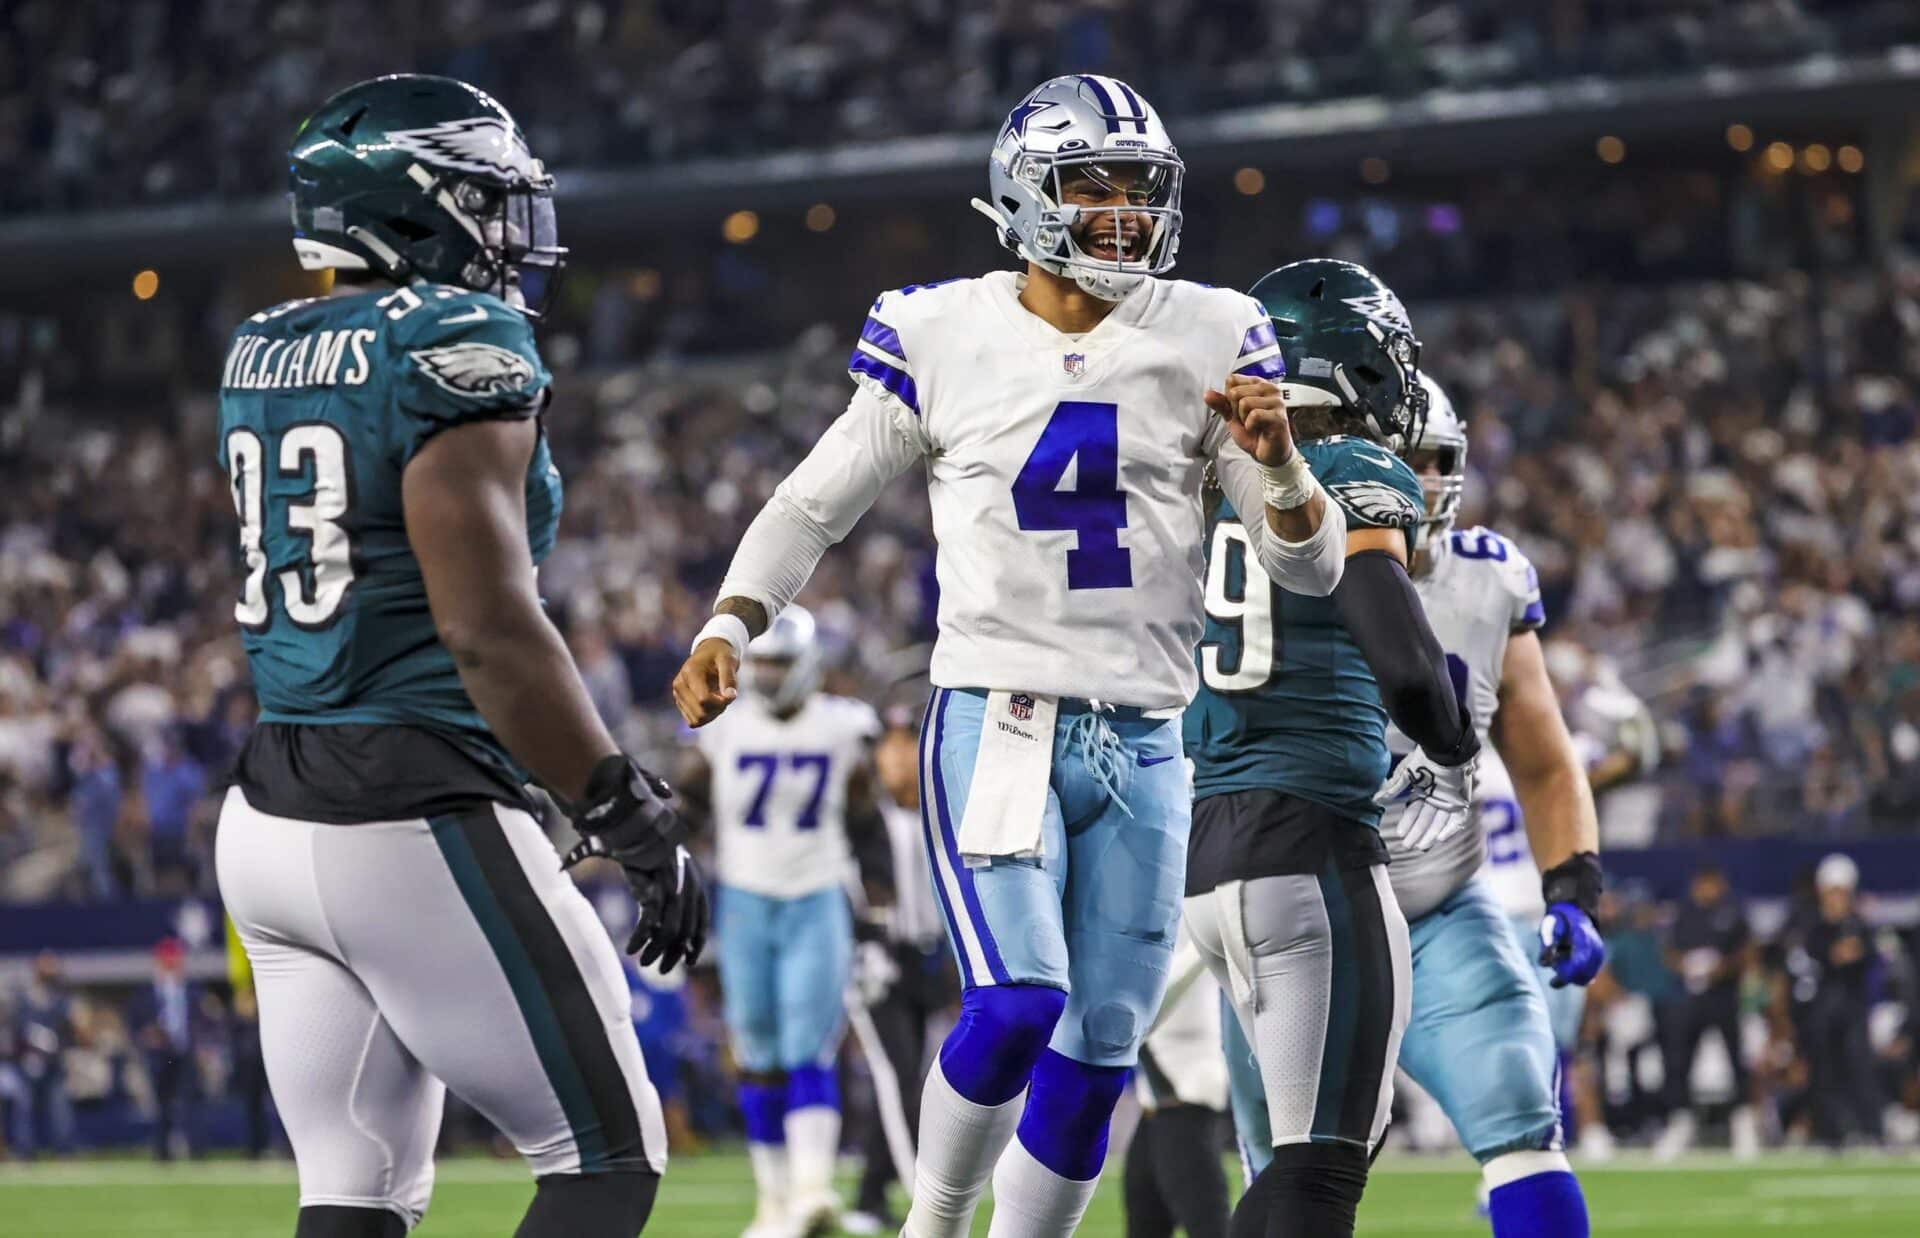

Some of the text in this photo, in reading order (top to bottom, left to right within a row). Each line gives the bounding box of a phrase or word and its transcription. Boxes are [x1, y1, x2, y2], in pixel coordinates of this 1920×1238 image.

[1011, 401, 1135, 590] 4
[1010, 703, 1032, 719] NFL
[737, 754, 830, 830] 77
